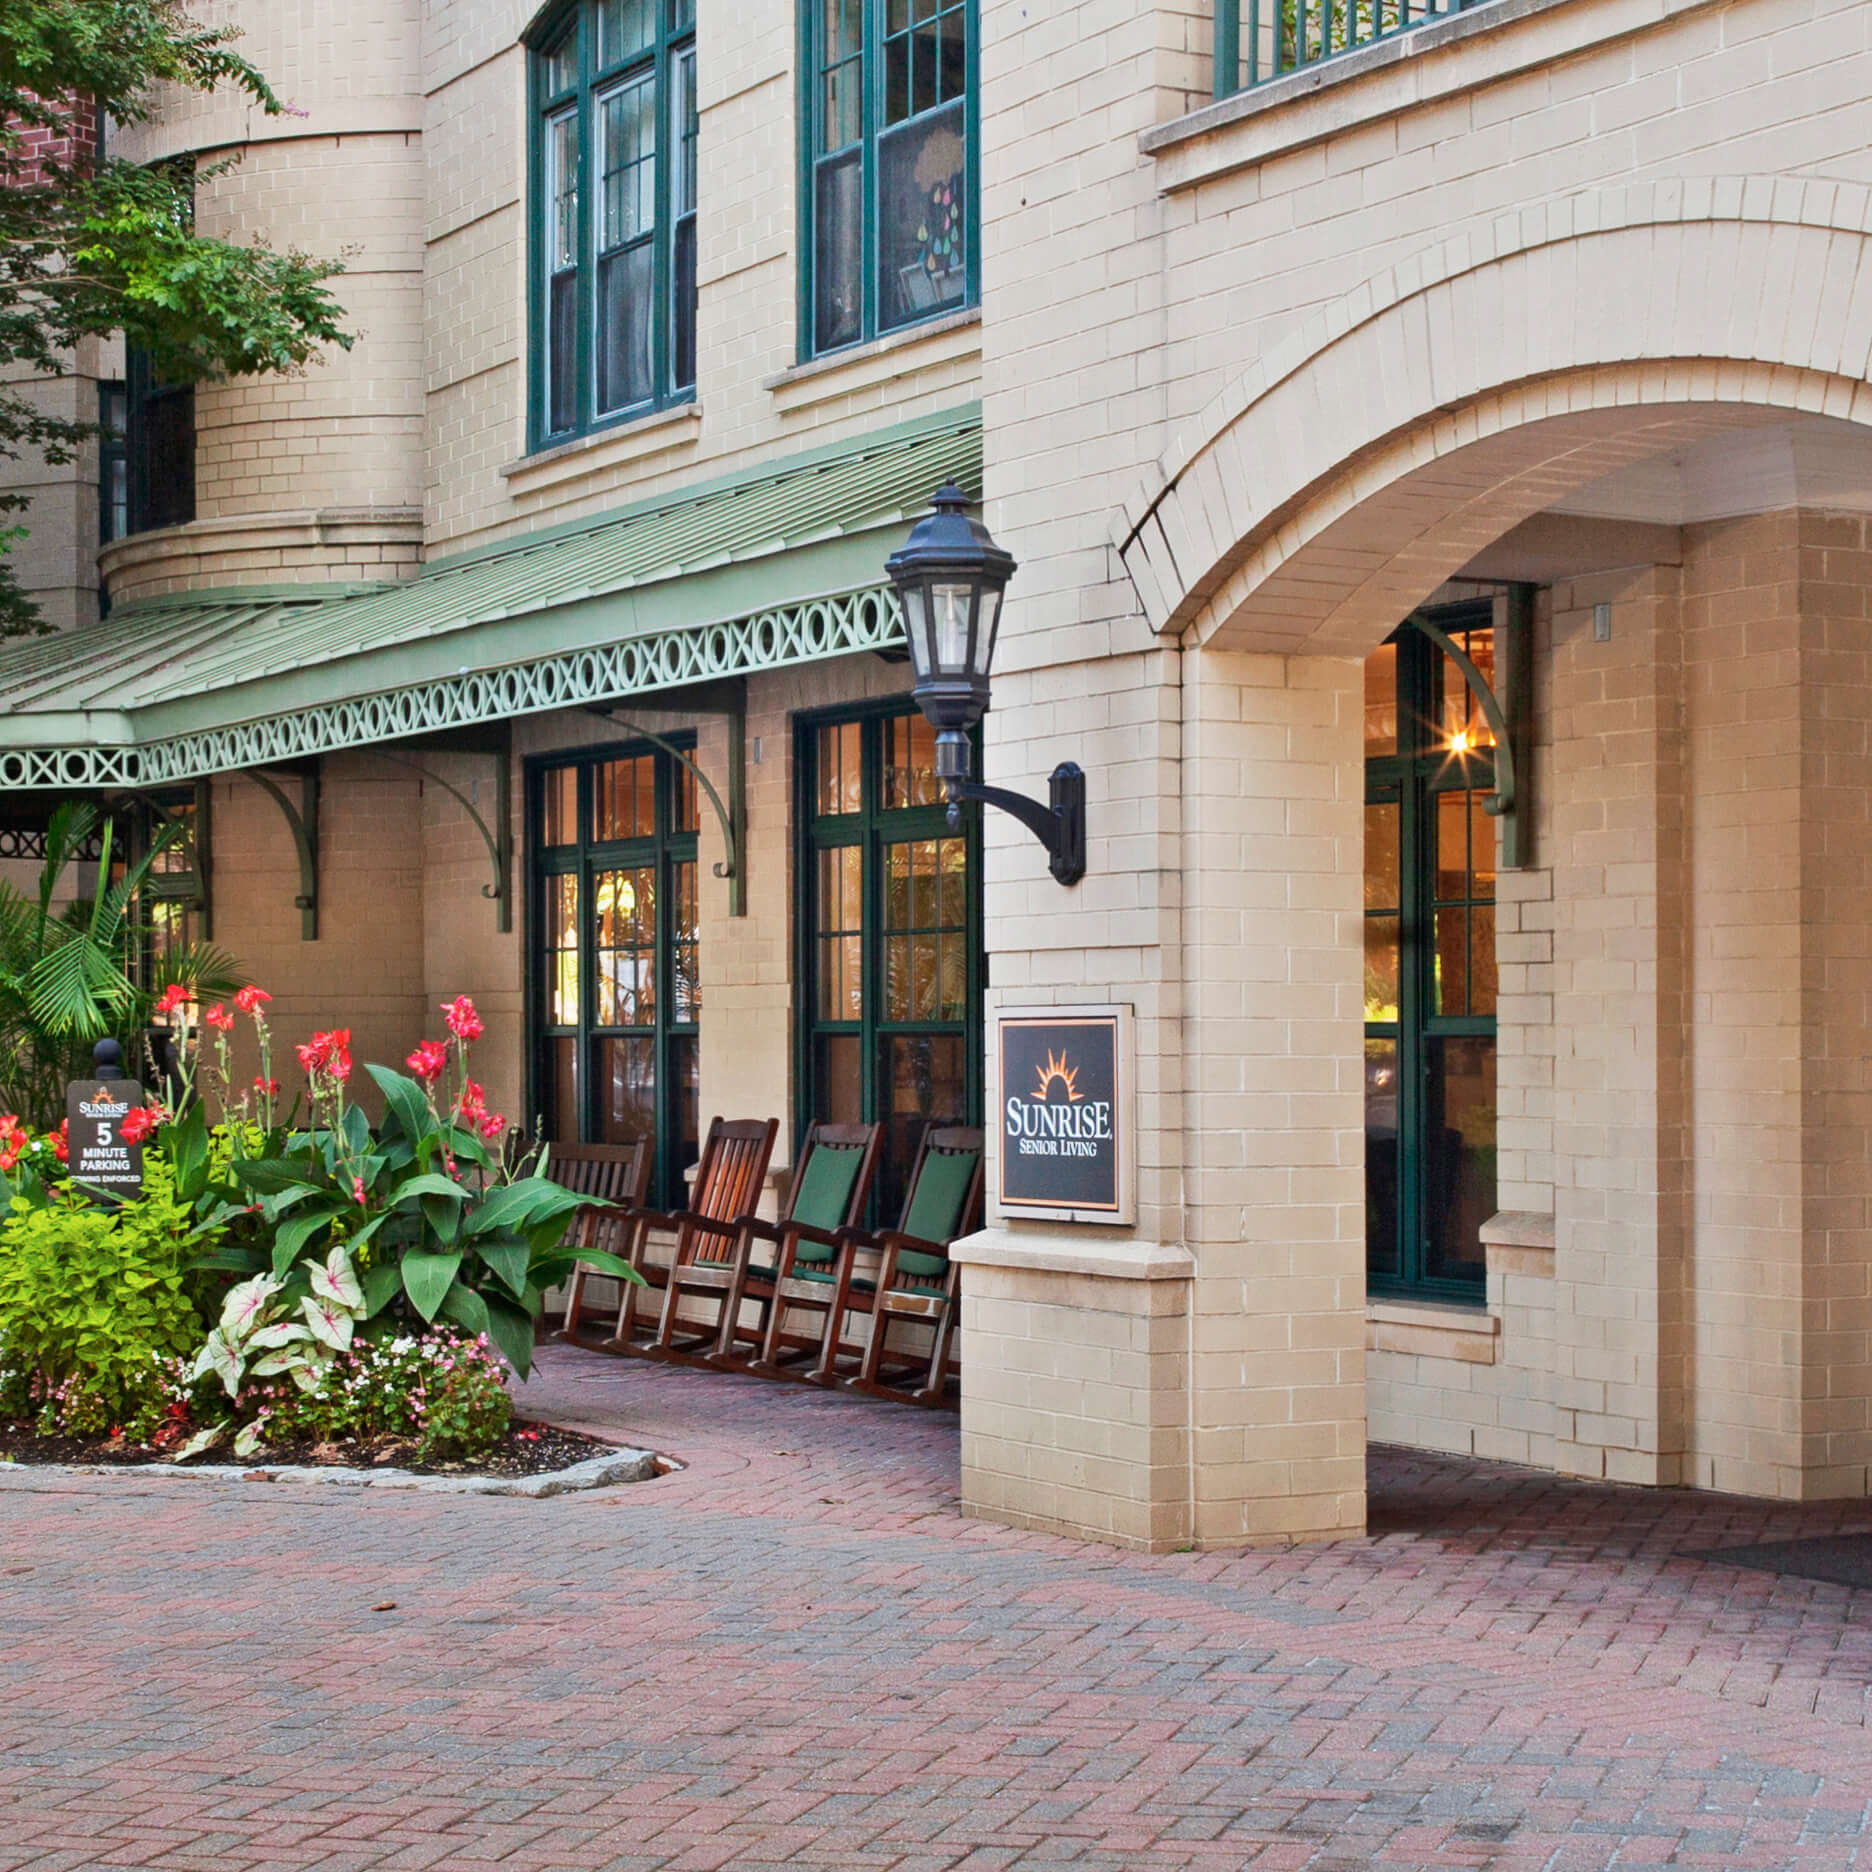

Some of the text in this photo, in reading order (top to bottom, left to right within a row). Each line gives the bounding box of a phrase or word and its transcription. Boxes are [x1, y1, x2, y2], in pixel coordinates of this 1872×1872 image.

[79, 1101, 129, 1114] SUNRISE
[1006, 1096, 1110, 1138] SUNRISE
[96, 1122, 113, 1146] 5
[82, 1148, 128, 1159] MINUTE
[1019, 1138, 1097, 1157] SENIOR LIVING
[80, 1160, 130, 1171] PARKING
